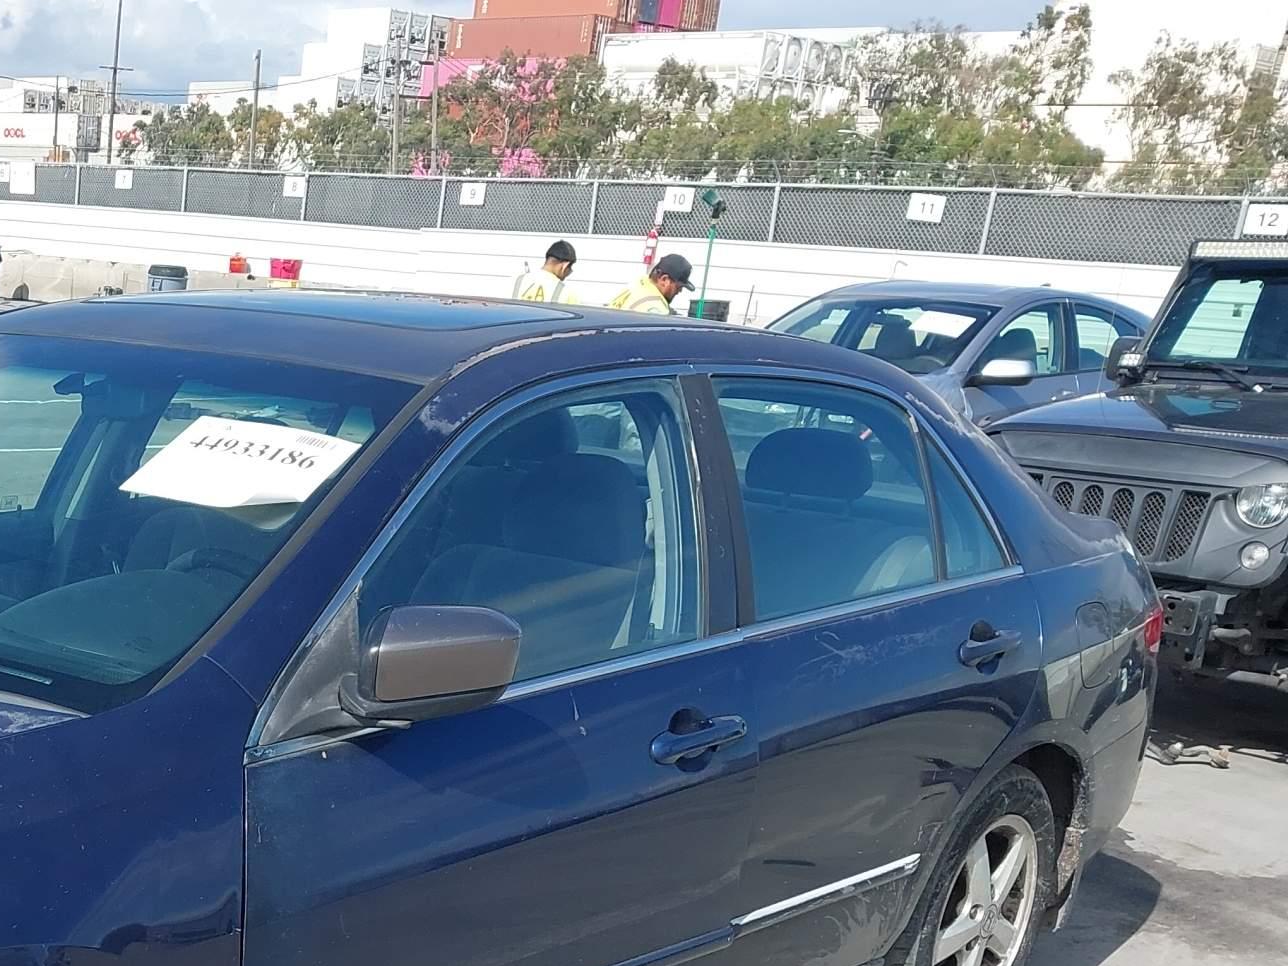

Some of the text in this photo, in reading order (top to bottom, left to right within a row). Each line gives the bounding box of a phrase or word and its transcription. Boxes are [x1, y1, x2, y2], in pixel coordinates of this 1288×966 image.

[4, 127, 26, 138] OOCL
[470, 189, 477, 199] 9
[672, 194, 686, 205] 10
[920, 202, 935, 215] 11
[1258, 212, 1280, 227] 12
[189, 435, 322, 470] 44933186
